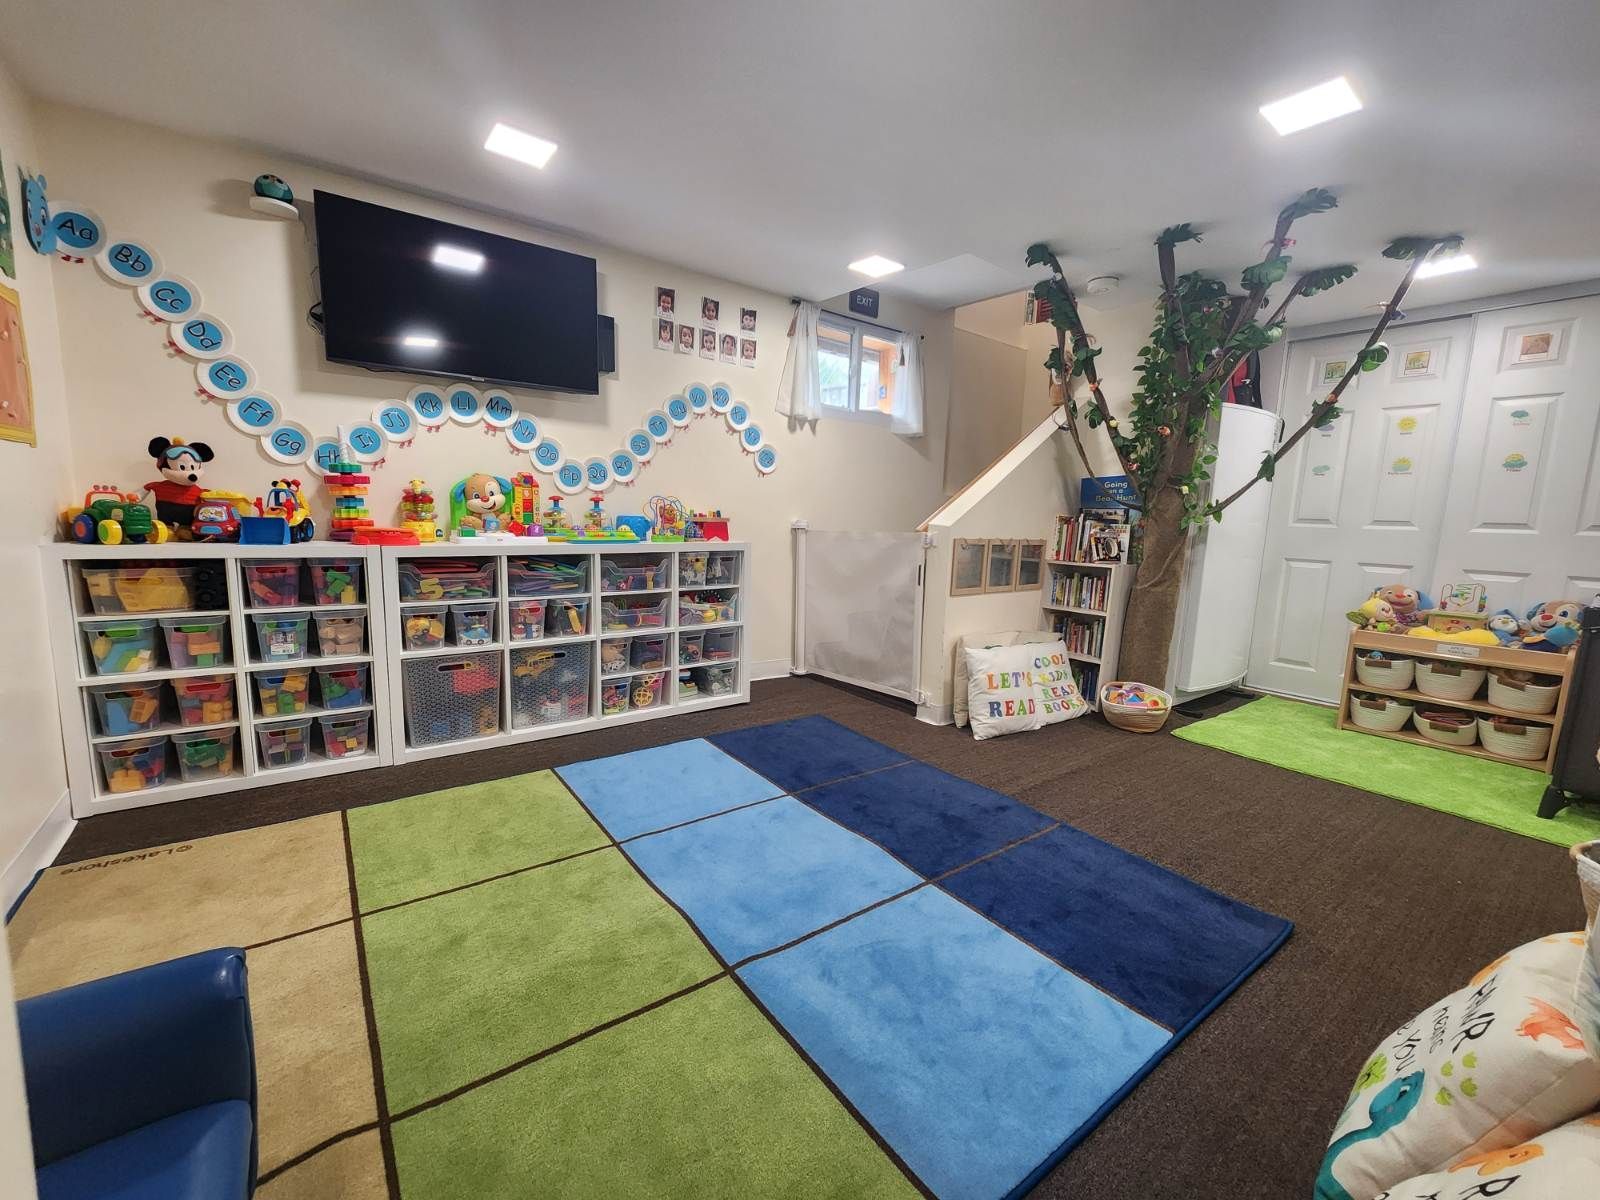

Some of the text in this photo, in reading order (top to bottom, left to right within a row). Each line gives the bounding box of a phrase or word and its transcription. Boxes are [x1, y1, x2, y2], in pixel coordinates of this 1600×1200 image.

[57, 218, 93, 241] Aa
[114, 246, 146, 271] Bb
[155, 287, 184, 310] Cc
[856, 295, 873, 307] EXIT
[187, 321, 223, 349] Dd
[214, 364, 241, 390] Ee
[243, 401, 273, 422] Ff
[485, 397, 512, 415] Mm
[514, 420, 536, 441] Nn
[275, 432, 302, 455] Gg
[631, 440, 647, 452] Ss
[538, 447, 557, 461] Oo
[562, 467, 579, 484] Pp
[587, 466, 606, 481] Qq
[1104, 481, 1128, 489] Going
[1034, 653, 1066, 669] COOL
[986, 671, 1033, 690] LET'S
[1042, 683, 1076, 699] READ
[988, 698, 1036, 717] READ
[1392, 1029, 1422, 1072] YOU
